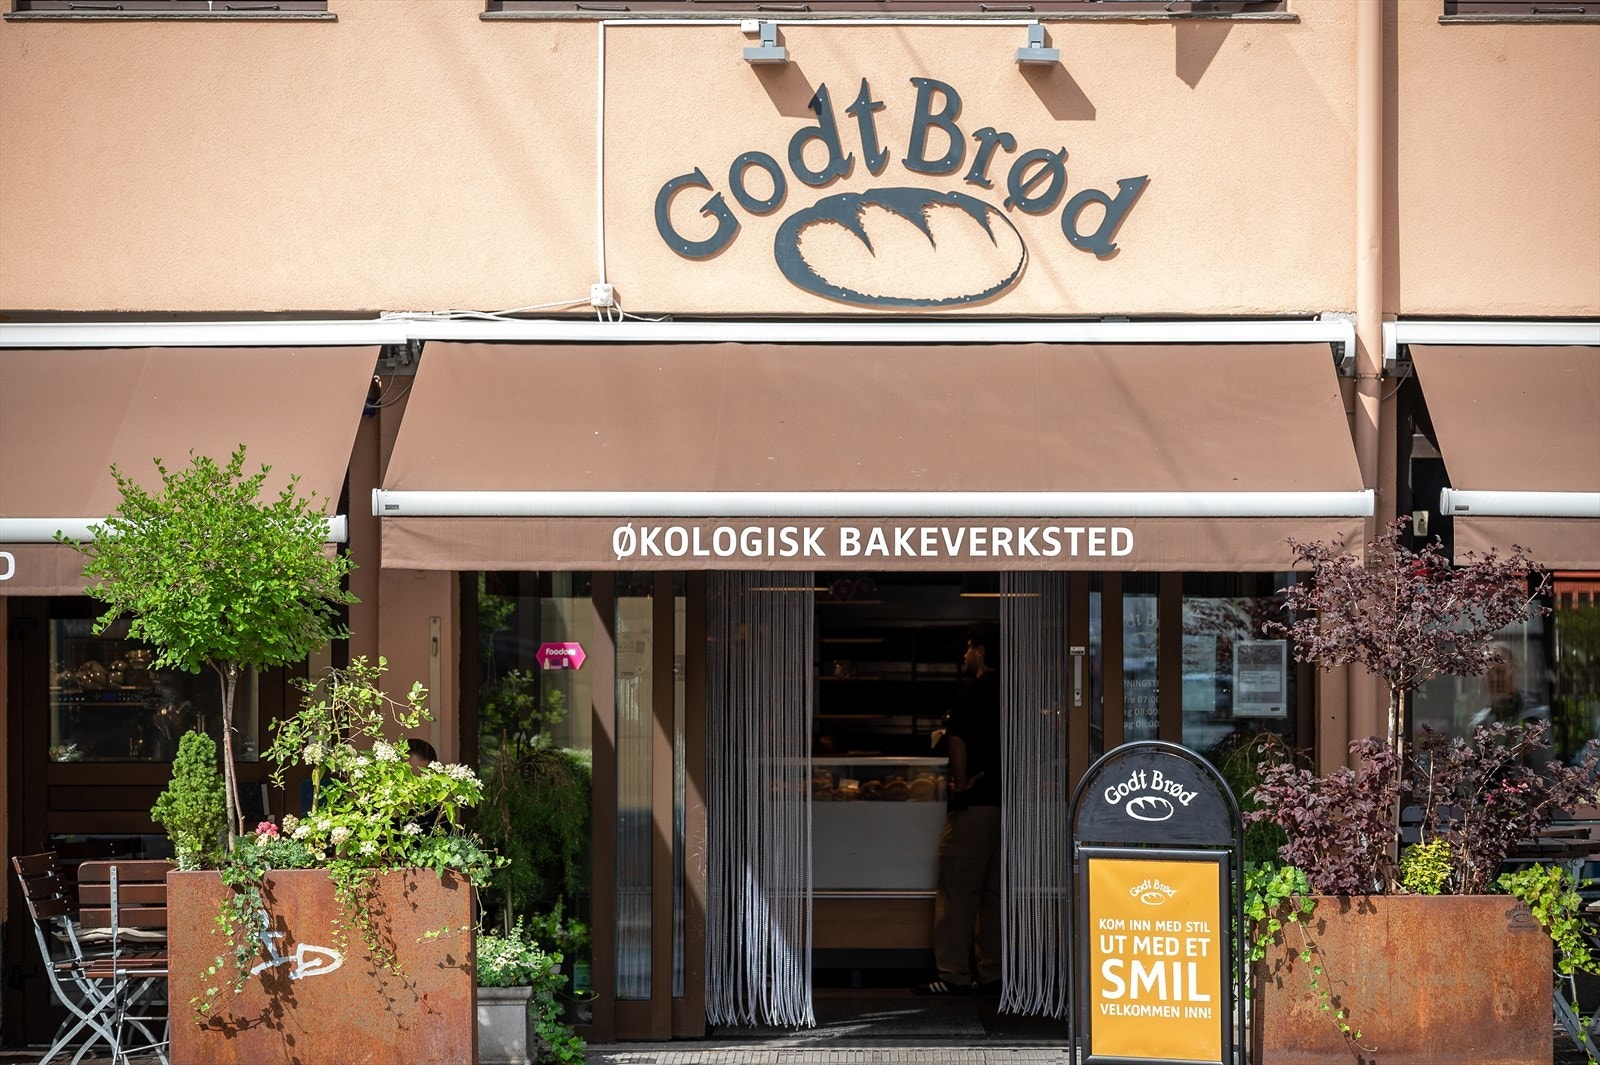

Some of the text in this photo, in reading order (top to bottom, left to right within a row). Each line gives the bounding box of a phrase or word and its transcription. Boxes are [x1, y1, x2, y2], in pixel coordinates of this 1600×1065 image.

[655, 77, 1149, 258] Godt Brød
[612, 523, 1134, 560] ØKOLOGISK BAKEVERKSTED
[1104, 769, 1198, 806] Godt Brød
[1130, 879, 1151, 896] Godt
[1099, 918, 1211, 933] KOM INN MED STIL
[1101, 935, 1211, 957] UT MED ET
[1101, 958, 1211, 1002] SMIL
[1100, 1004, 1212, 1019] VELKOMMEN INN!
